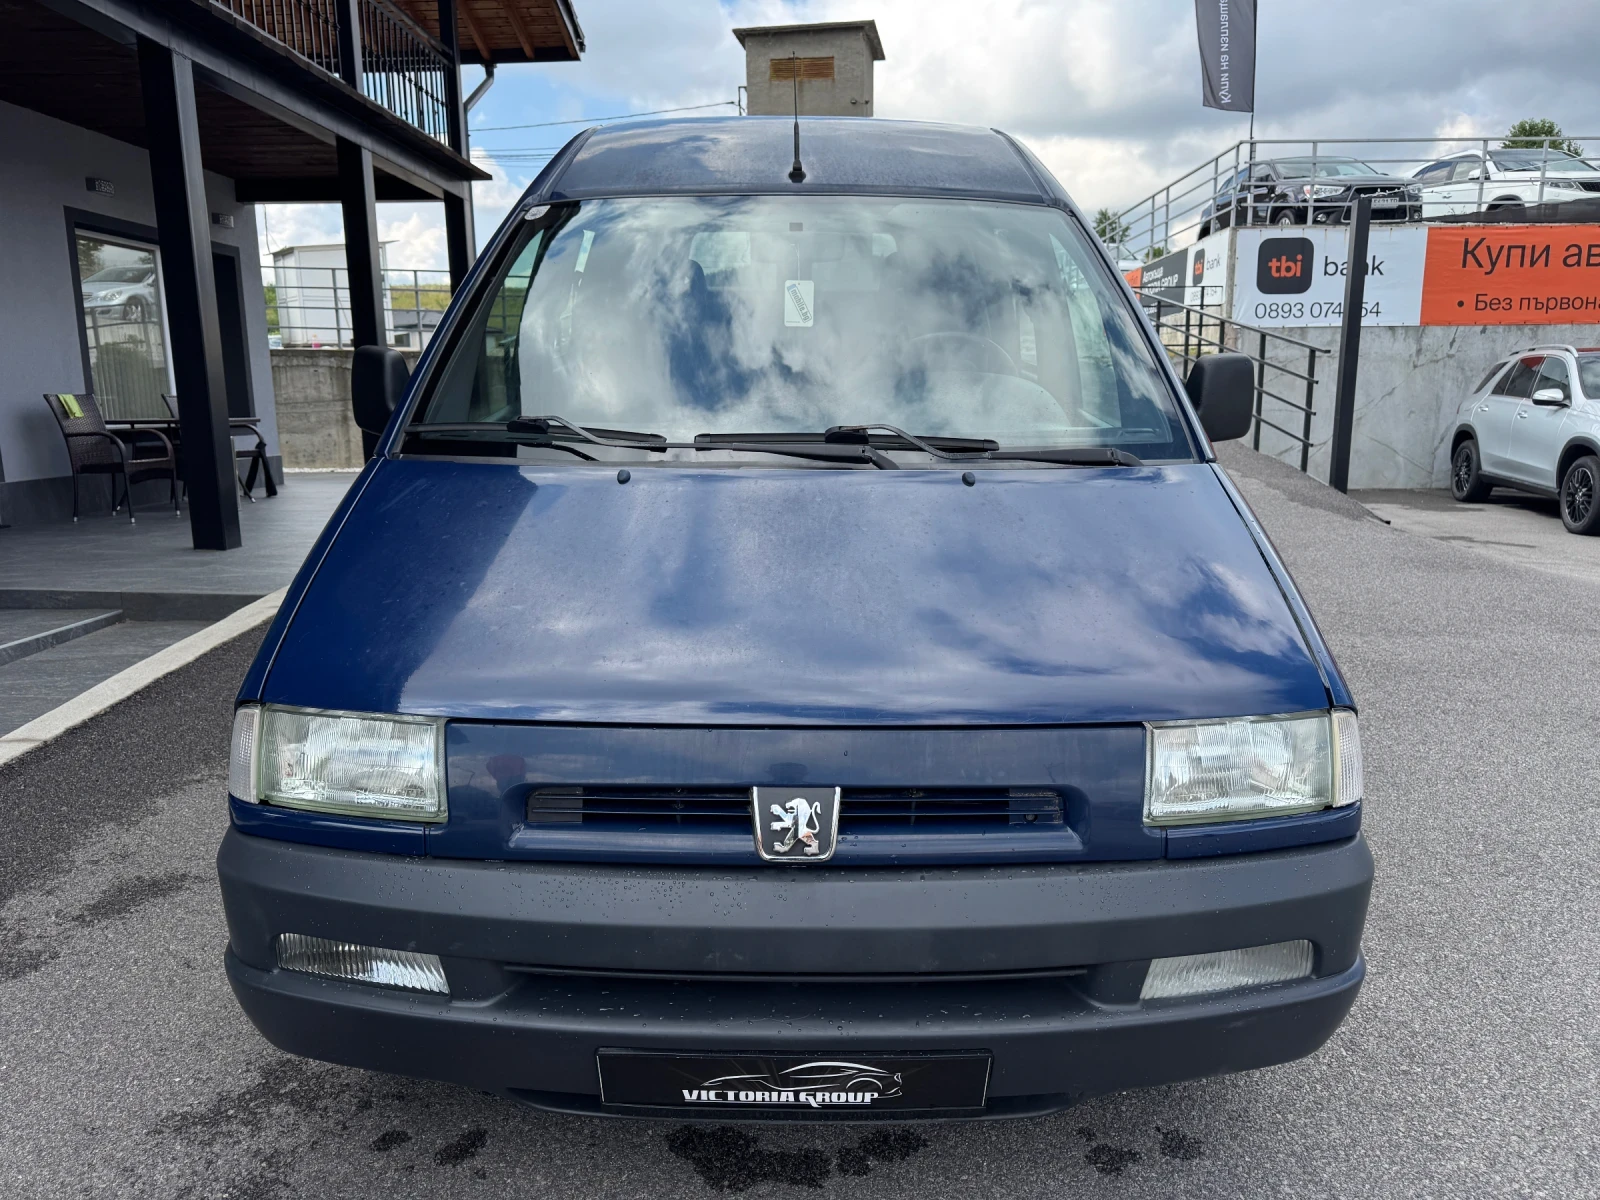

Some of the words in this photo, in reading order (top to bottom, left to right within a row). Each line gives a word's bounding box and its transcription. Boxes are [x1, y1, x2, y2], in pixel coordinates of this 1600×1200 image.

[1206, 253, 1221, 271] bank
[1461, 237, 1551, 275] Купи
[1268, 254, 1303, 278] tbi
[1323, 255, 1385, 276] bak
[1255, 302, 1304, 319] 0893
[1310, 301, 1382, 318] 07454
[1474, 293, 1513, 311] Без
[1519, 296, 1600, 314] първон
[682, 1089, 795, 1102] VICTORIA
[799, 1091, 879, 1107] GROUP
